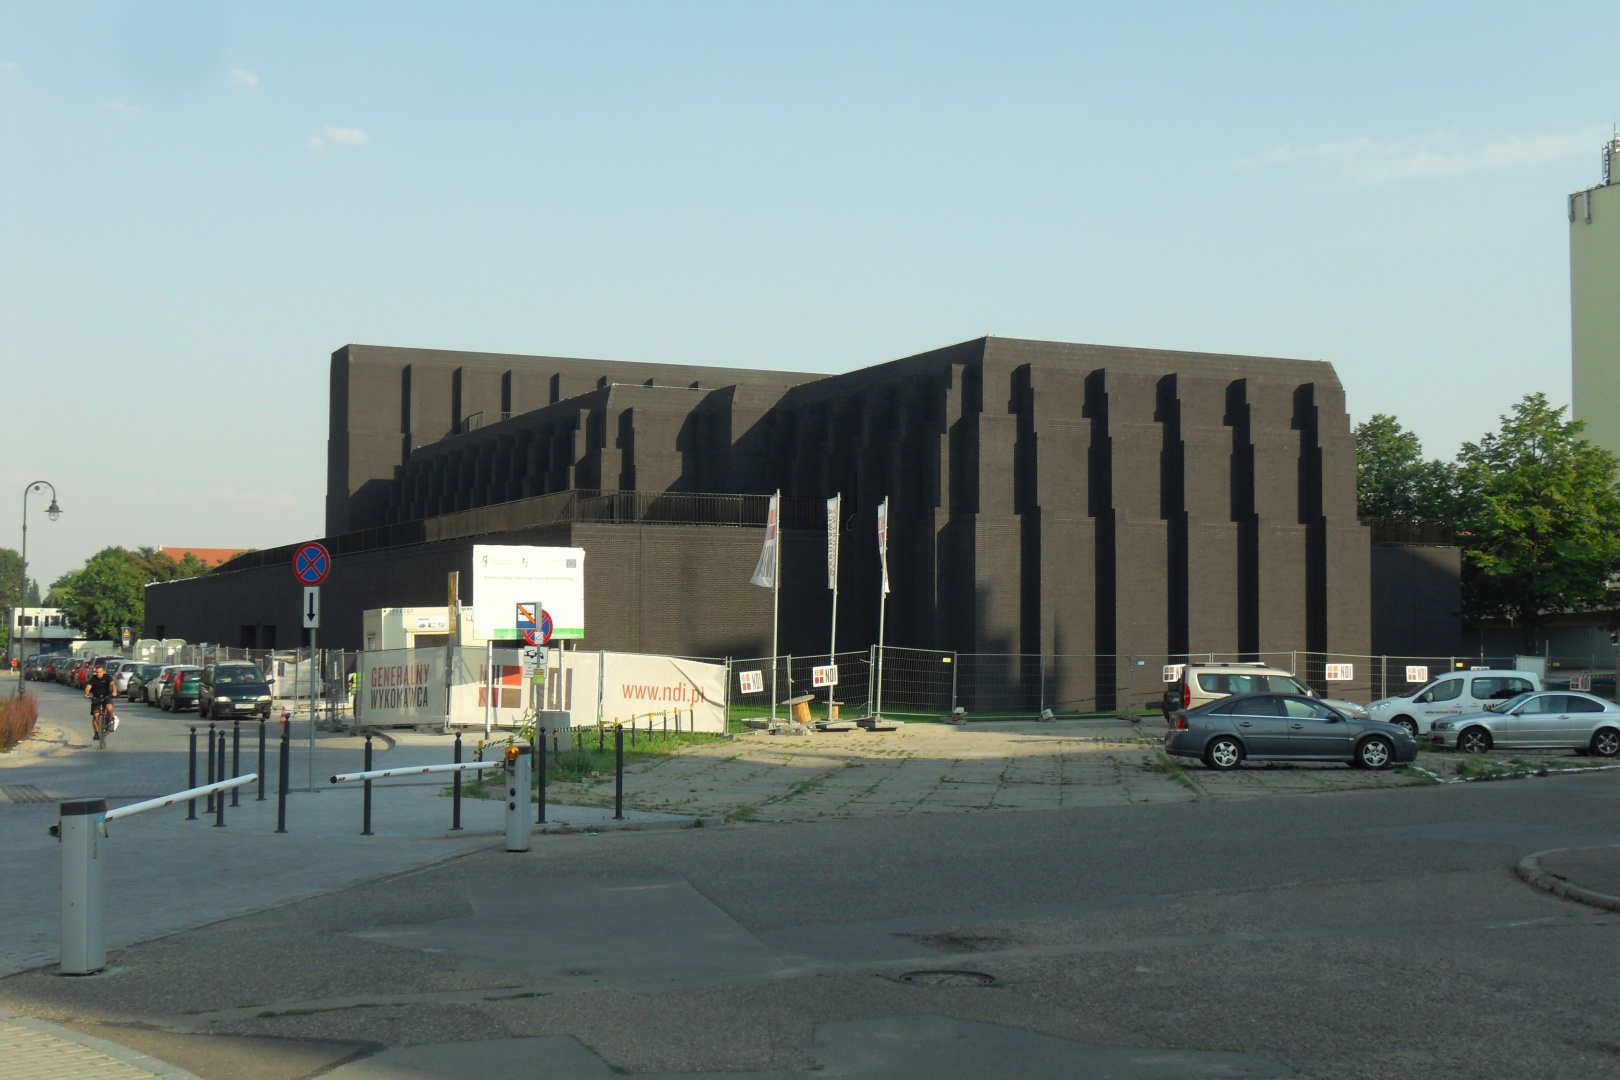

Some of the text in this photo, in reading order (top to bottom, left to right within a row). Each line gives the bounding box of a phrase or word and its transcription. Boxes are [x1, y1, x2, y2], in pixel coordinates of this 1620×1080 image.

[371, 664, 430, 687] GENERALNY
[824, 667, 837, 684] NDI
[370, 687, 429, 709] WYKONAWCA
[622, 682, 704, 703] www.ndi.pl
